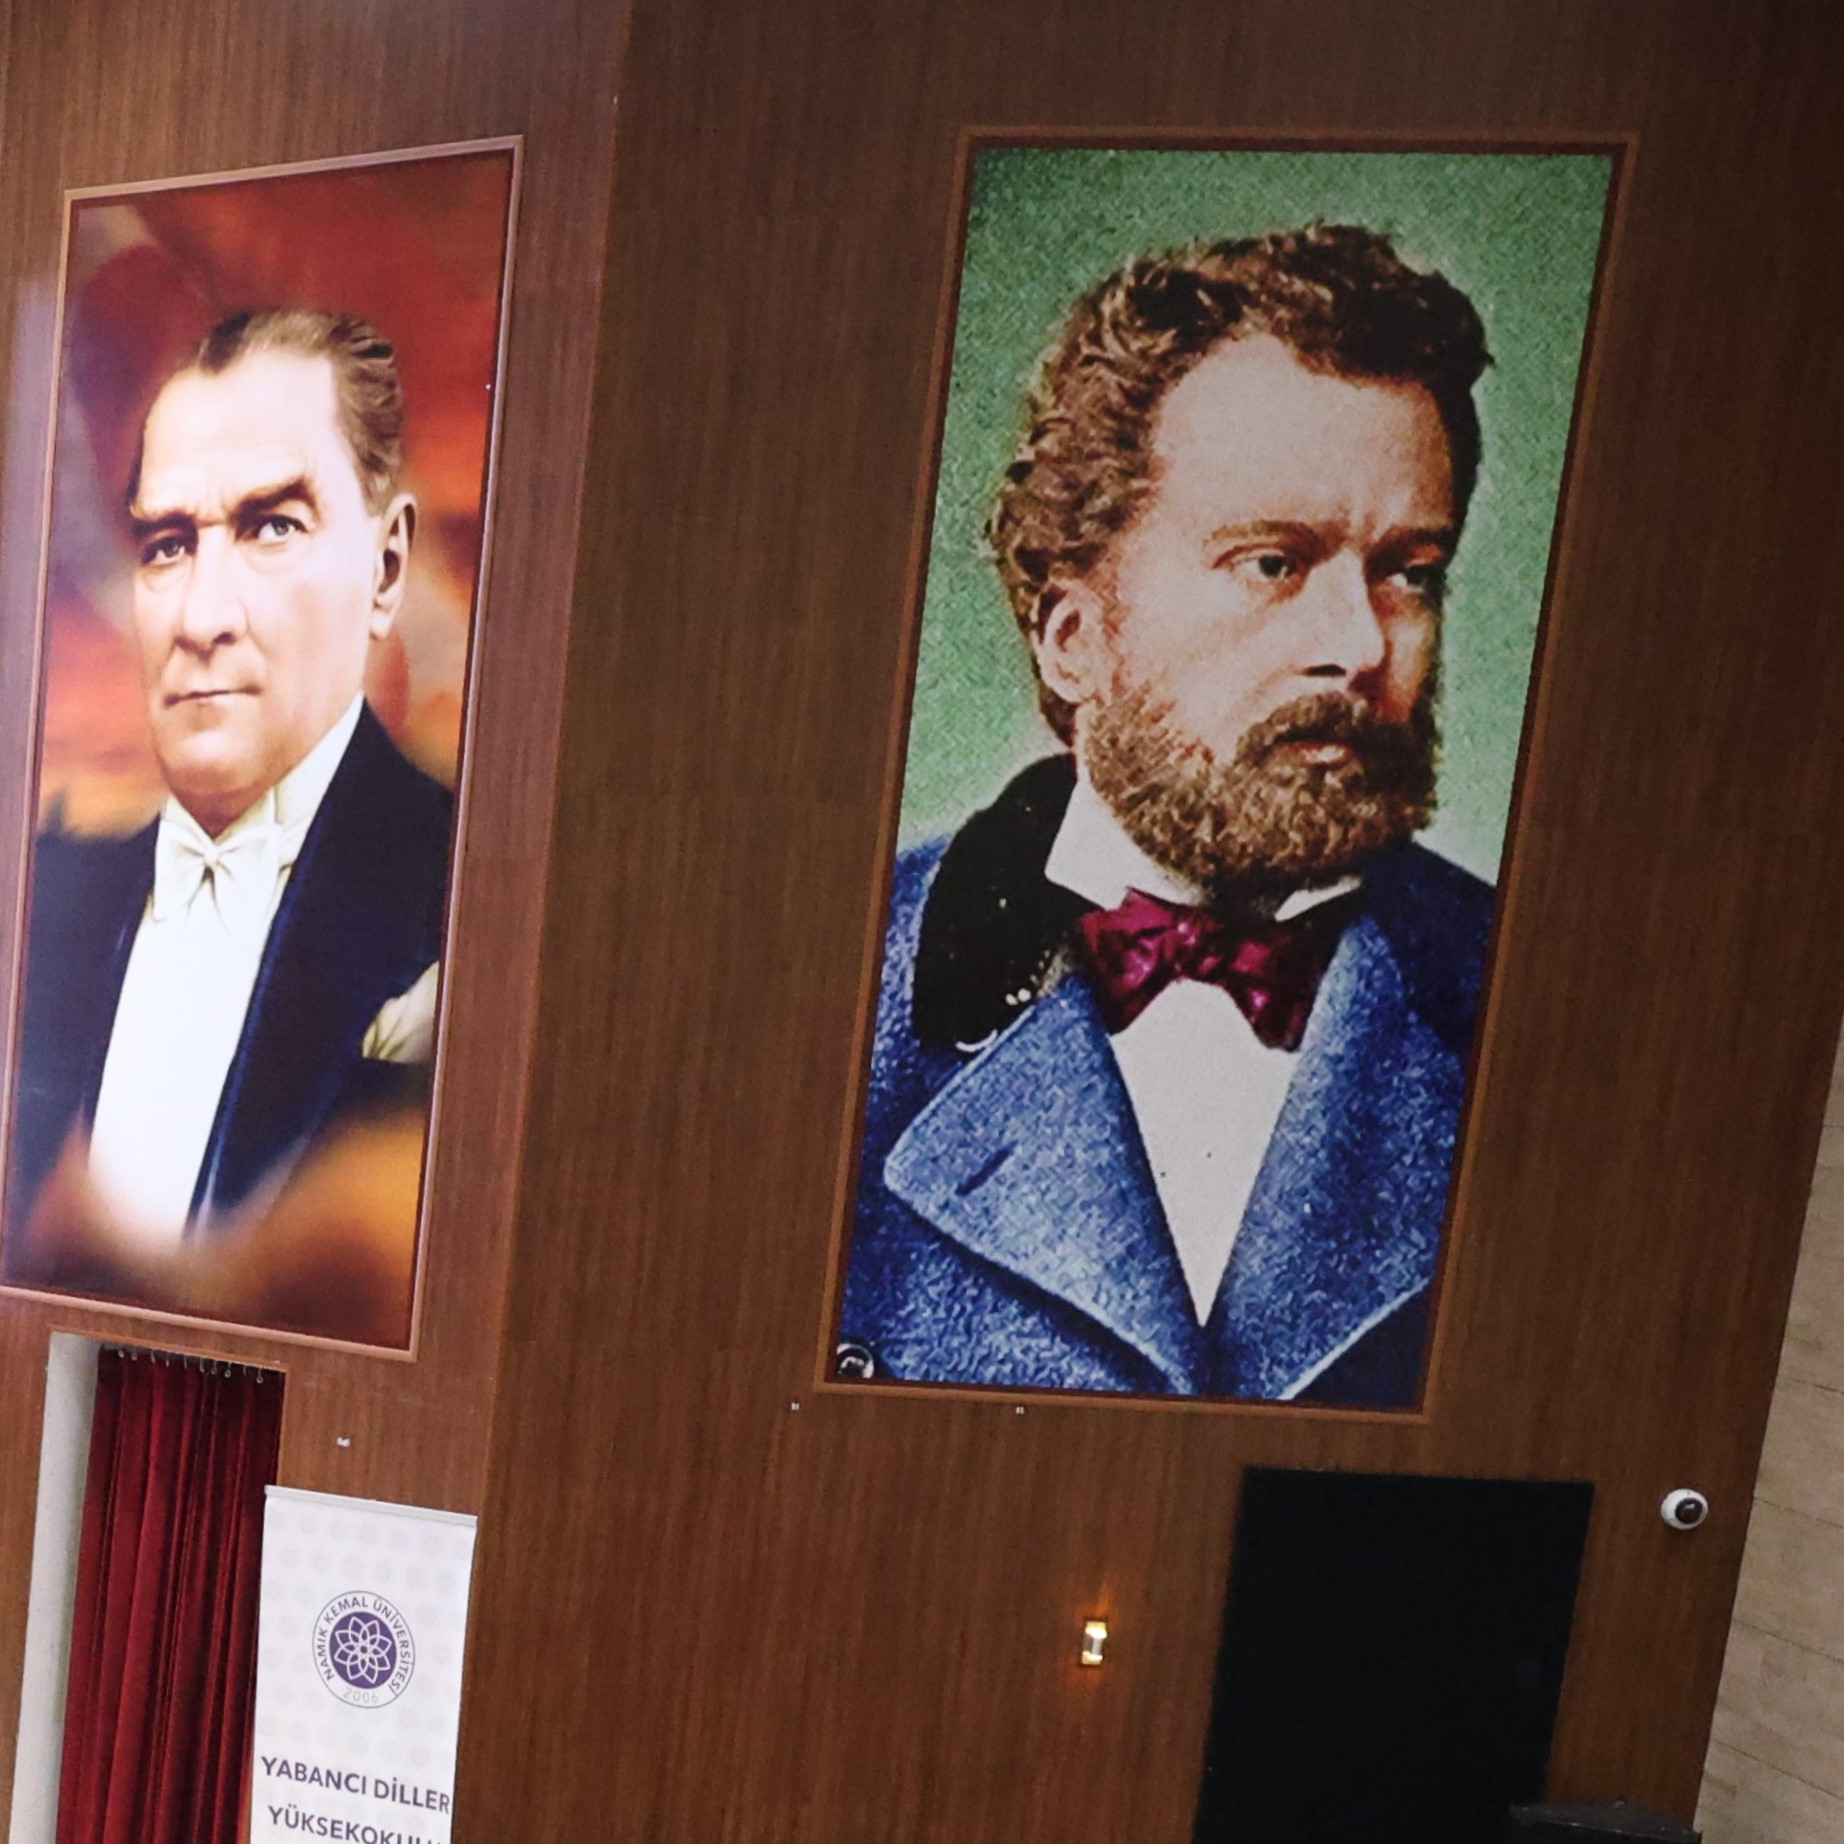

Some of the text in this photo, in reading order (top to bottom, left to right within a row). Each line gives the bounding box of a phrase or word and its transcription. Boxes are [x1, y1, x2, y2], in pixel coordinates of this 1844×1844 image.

[323, 1596, 369, 1625] KEMAL
[317, 1626, 335, 1681] NAMIK
[261, 1755, 450, 1815] YABANCI DİLLER
